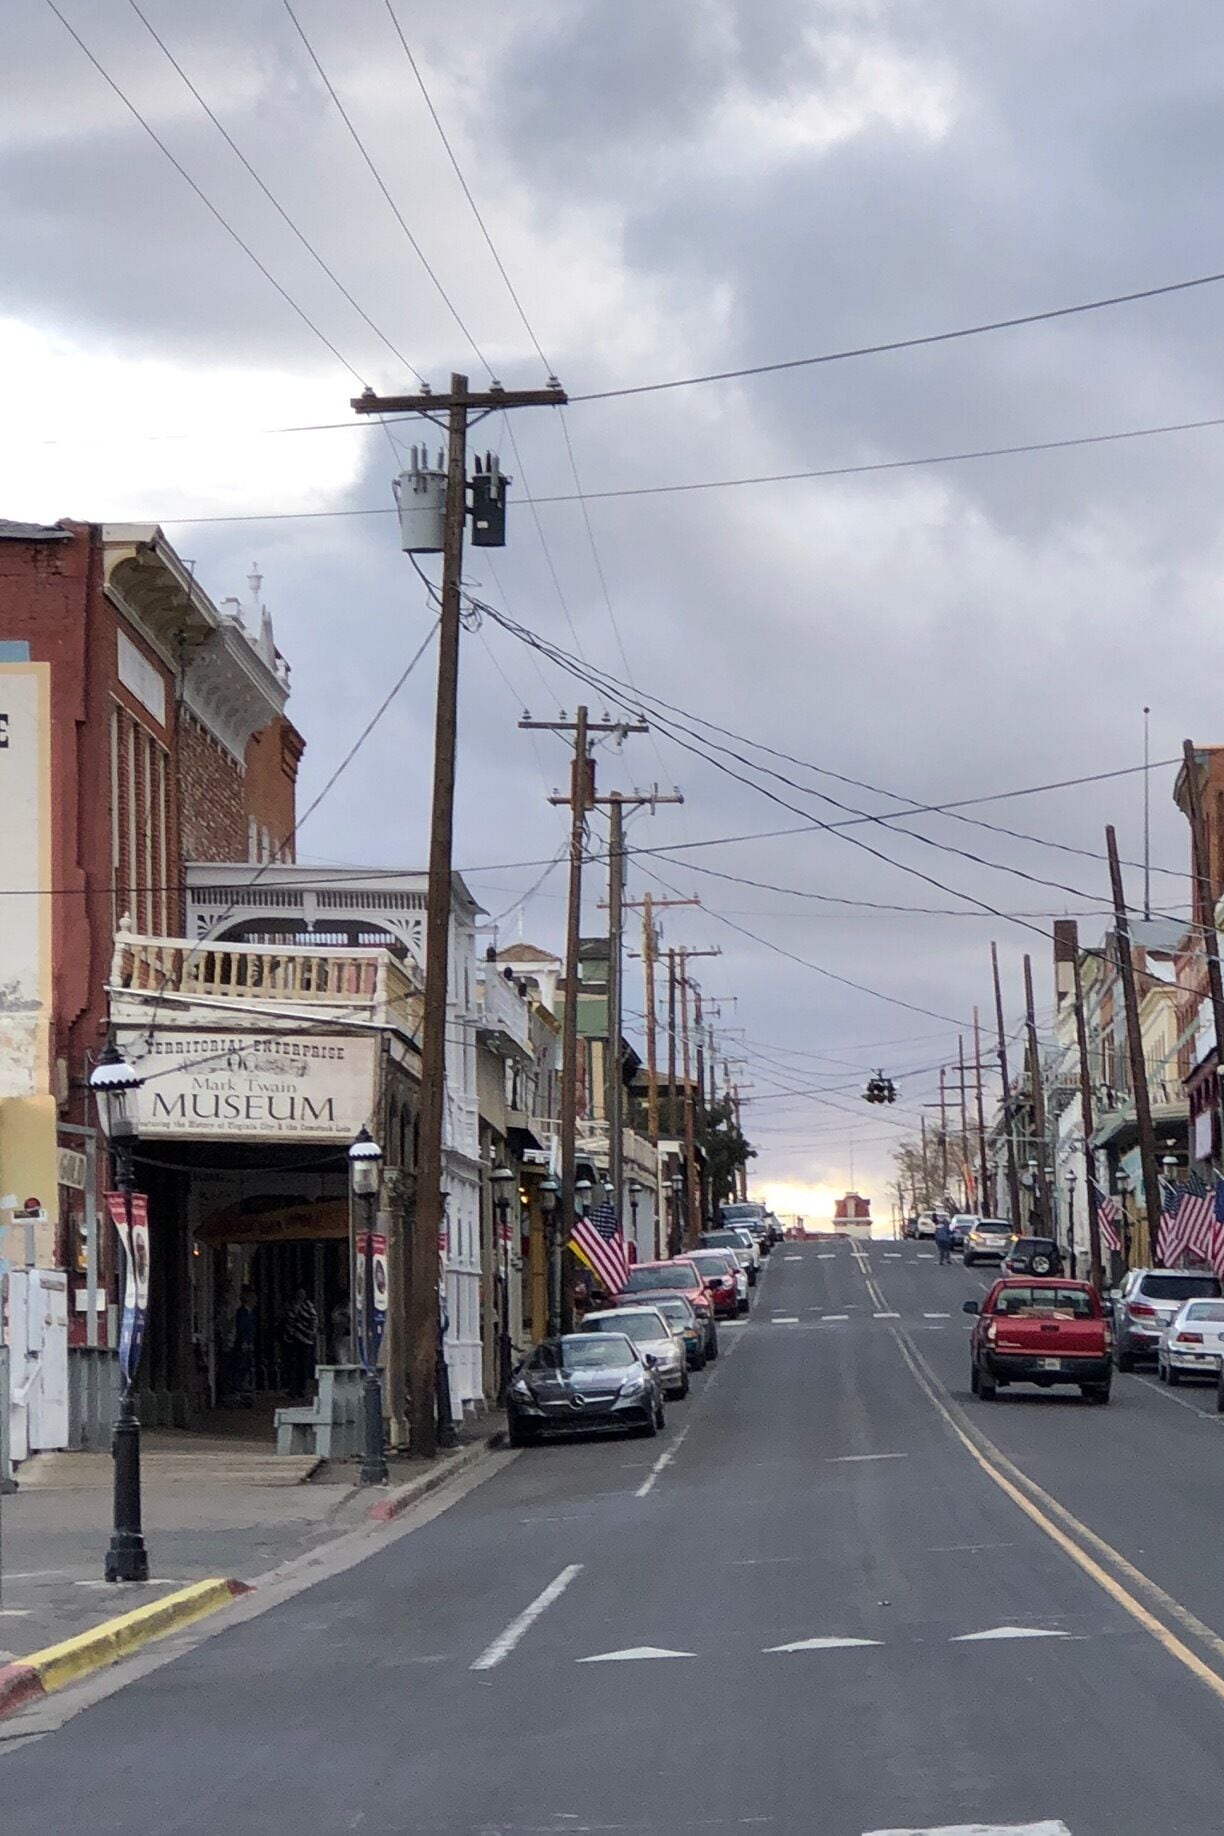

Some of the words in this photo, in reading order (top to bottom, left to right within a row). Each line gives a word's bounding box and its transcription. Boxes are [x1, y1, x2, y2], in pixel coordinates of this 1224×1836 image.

[147, 1038, 244, 1056] TERRITORIAL
[253, 1039, 345, 1060] ENTERPRISE
[192, 1077, 236, 1092] Mark
[244, 1078, 298, 1094] Twain
[152, 1092, 335, 1122] MUSEUM
